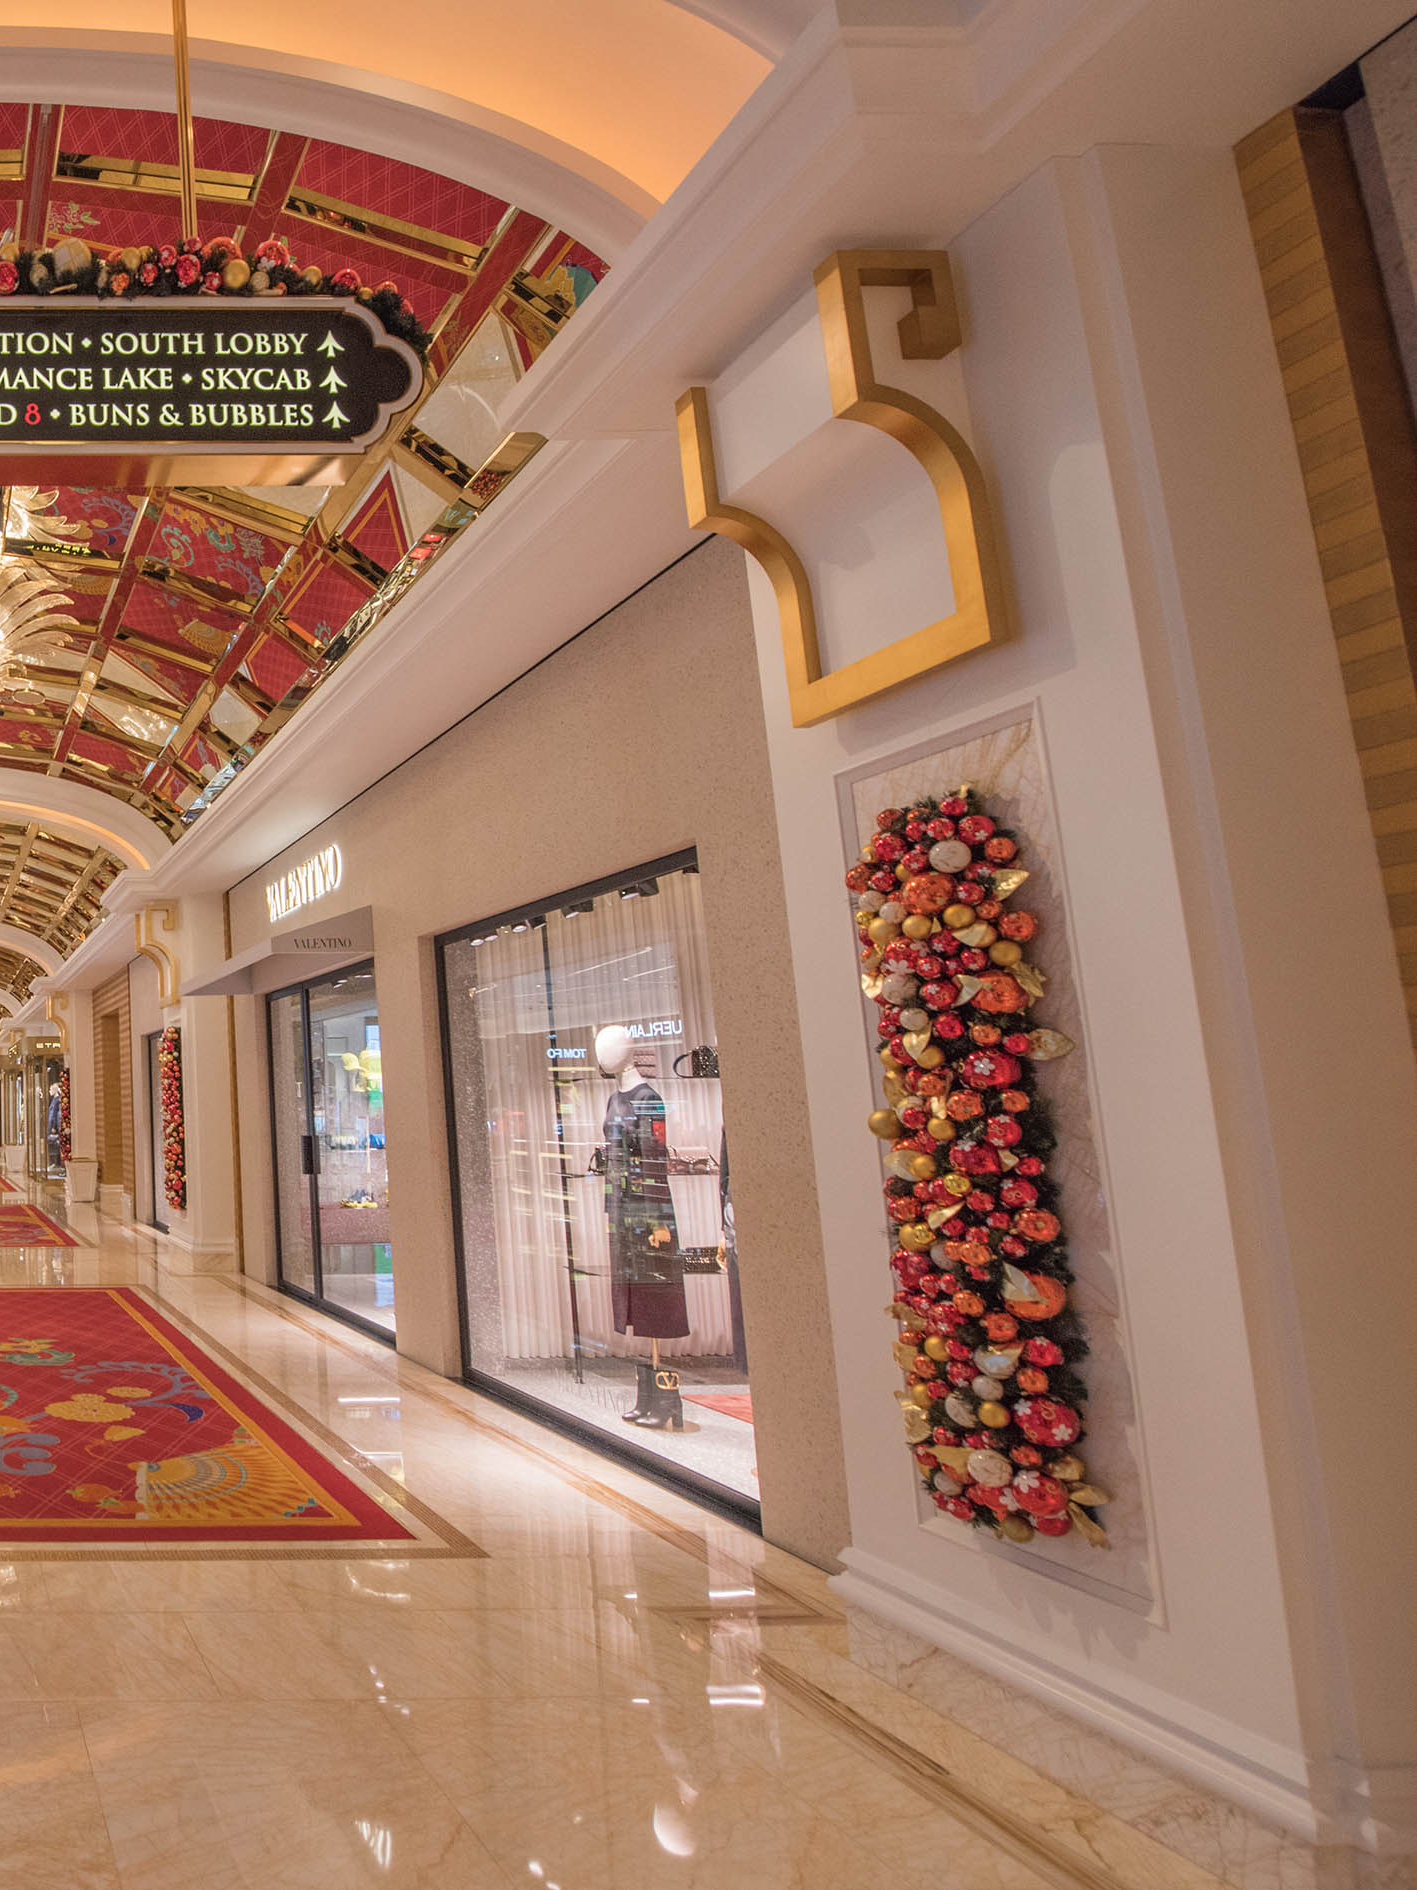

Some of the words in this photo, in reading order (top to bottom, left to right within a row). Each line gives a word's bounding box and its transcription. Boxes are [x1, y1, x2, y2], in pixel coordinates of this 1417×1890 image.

[100, 332, 206, 355] SOUTH
[214, 332, 309, 355] LOBBY
[101, 367, 174, 390] LAKE
[201, 367, 312, 391] SKYCAB
[23, 403, 42, 426] 8
[68, 403, 151, 427] BUNS
[158, 403, 185, 427] &
[188, 403, 314, 427] BUBBLES
[266, 844, 342, 923] VALENTINO
[293, 937, 352, 949] VALENTINO
